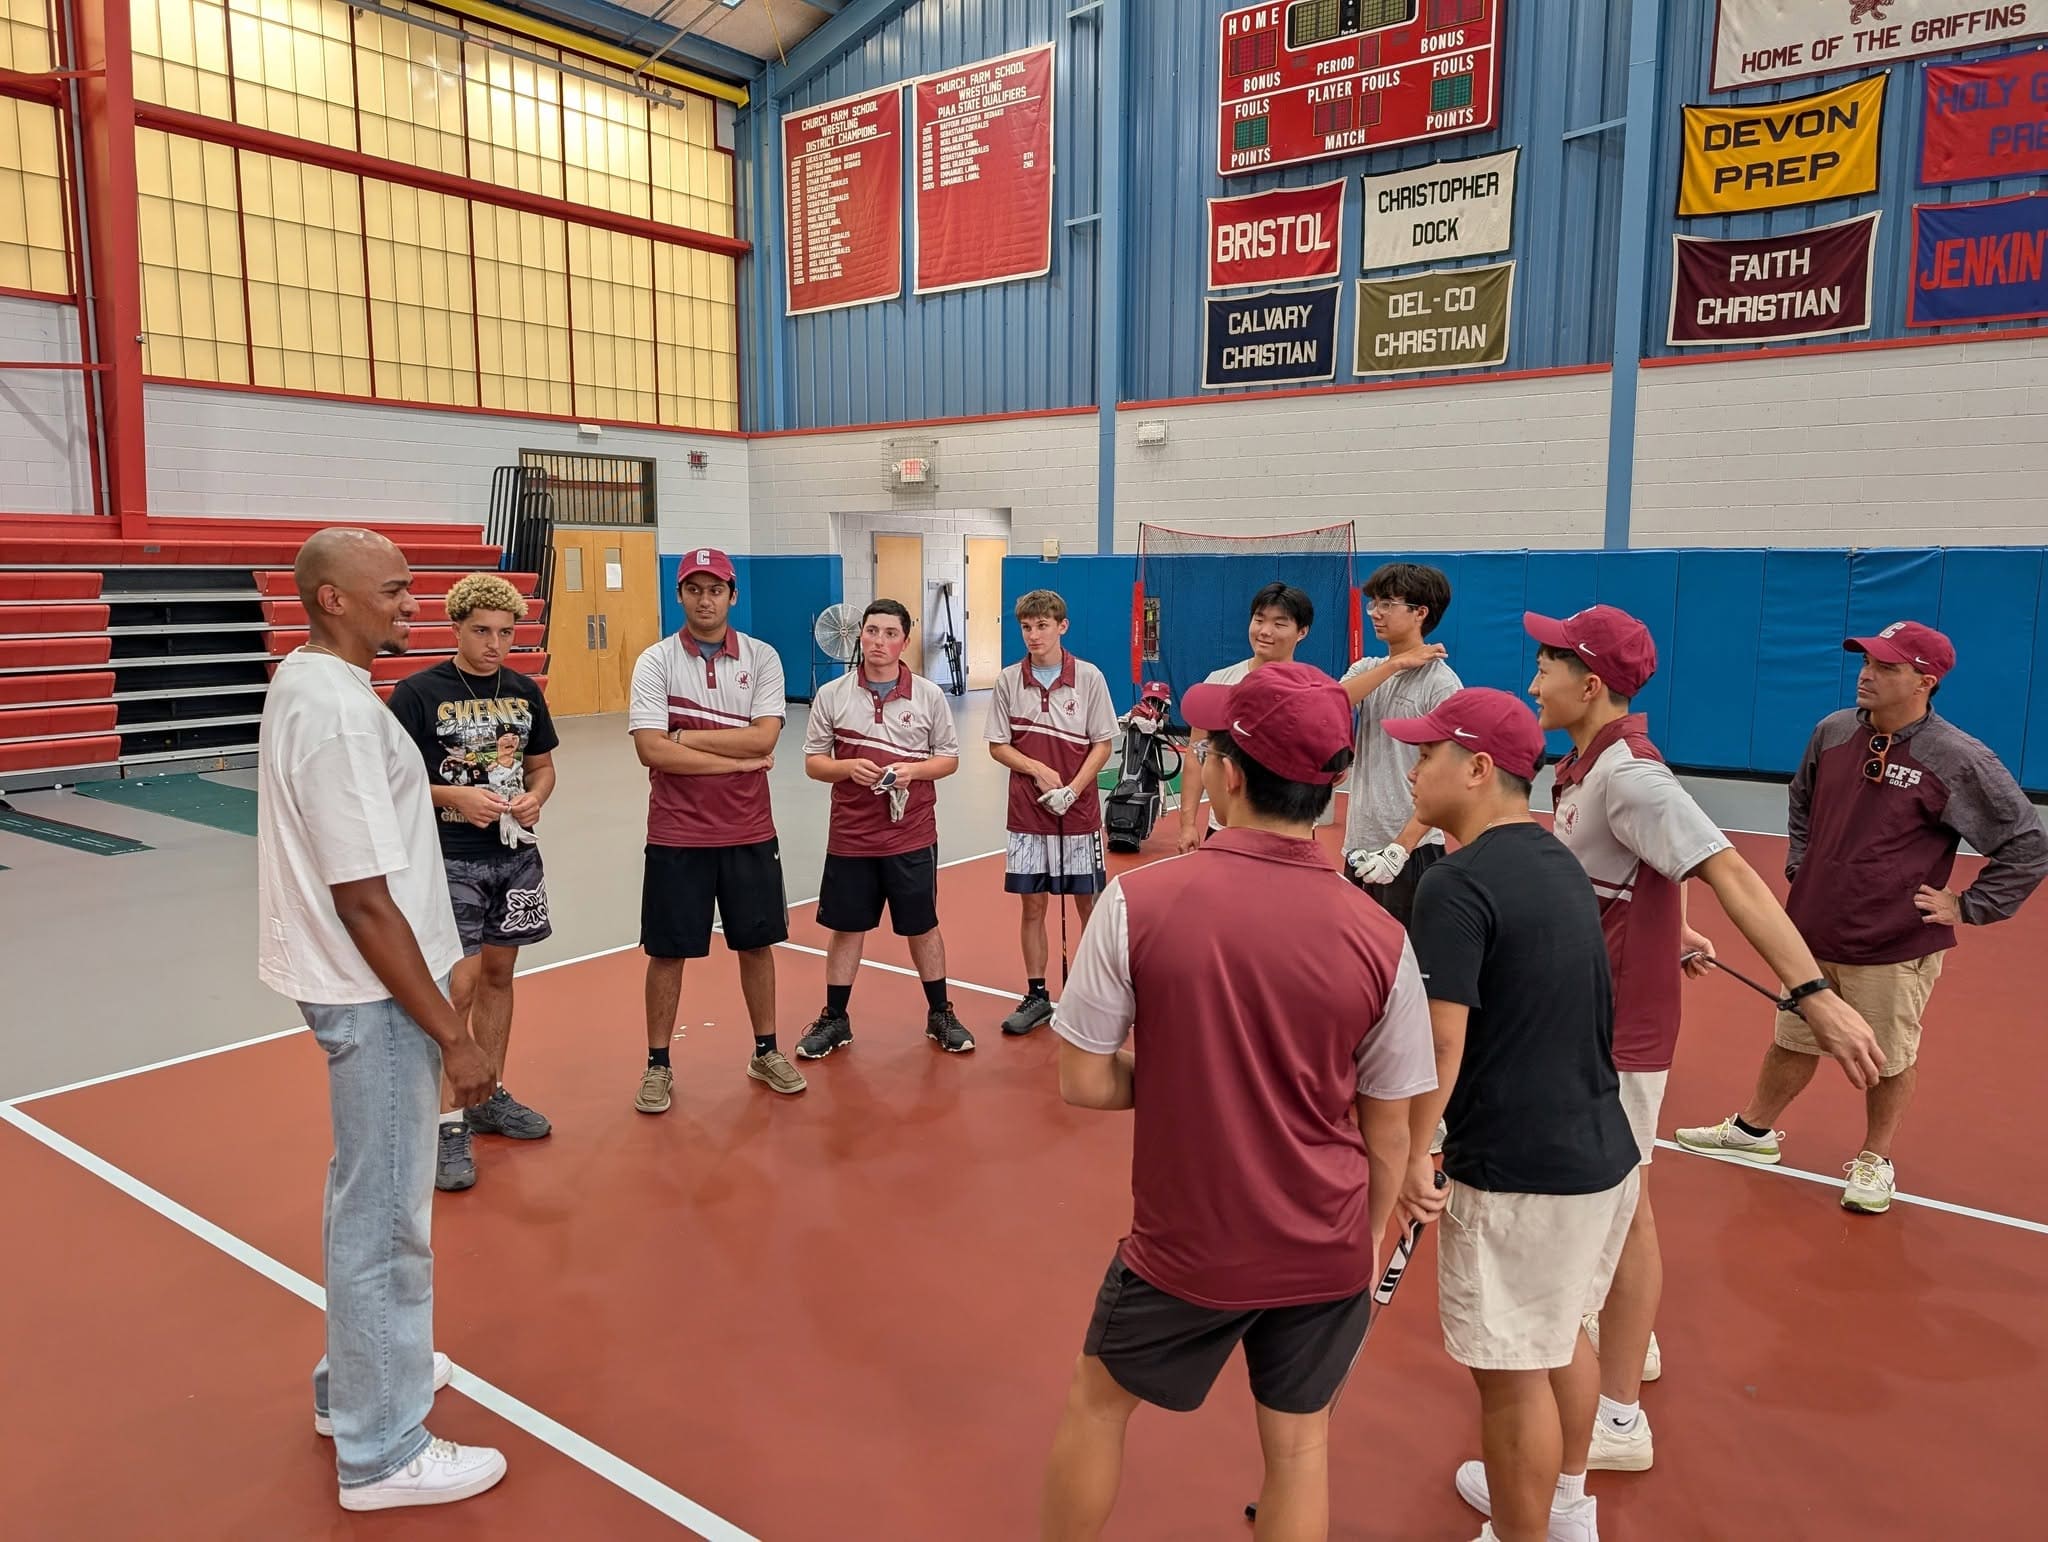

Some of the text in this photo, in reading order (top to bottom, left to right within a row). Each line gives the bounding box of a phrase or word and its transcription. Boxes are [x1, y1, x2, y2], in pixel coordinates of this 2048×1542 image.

[1229, 7, 1280, 35] HOME
[1421, 30, 1464, 54] BONUS
[1741, 3, 2027, 74] HOME OF THE GRIFFINS
[936, 60, 1025, 95] CHURCH FARM SCHOOL
[1317, 56, 1354, 75] PERIOD
[1433, 55, 1474, 78] FOULS
[959, 80, 1002, 101] WRESTLING
[1243, 72, 1281, 93] BONUS
[1307, 71, 1400, 104] PLAYER FOULS
[1936, 74, 2021, 115] HOLY
[802, 101, 878, 131] CHURCH FARM SCHOOL
[938, 86, 1026, 119] PIAA STATE QUALIFIERS
[1235, 99, 1270, 119] FOULS
[821, 117, 858, 136] WRESTLING
[1426, 108, 1474, 131] POINTS
[1703, 102, 1859, 152] DEVON
[806, 125, 877, 152] DISTRICT CHAMPIONS
[1325, 130, 1365, 150] MATCH
[1231, 148, 1271, 168] POINTS
[1714, 151, 1839, 194] PREP
[1378, 171, 1499, 214] CHRISTOPHER
[1217, 214, 1331, 263] BRISTOL
[1413, 218, 1459, 246] DOCK
[1729, 247, 1810, 283] FAITH
[1920, 232, 2048, 290] JENKIN
[1229, 305, 1312, 335] CALVARY
[1696, 286, 1841, 326] CHRISTIAN
[1375, 324, 1486, 358] CHRISTIAN
[1222, 341, 1316, 370] CHRISTIAN
[696, 549, 711, 565] C
[1885, 763, 1923, 785] CFS
[1889, 778, 1911, 788] GOLF
